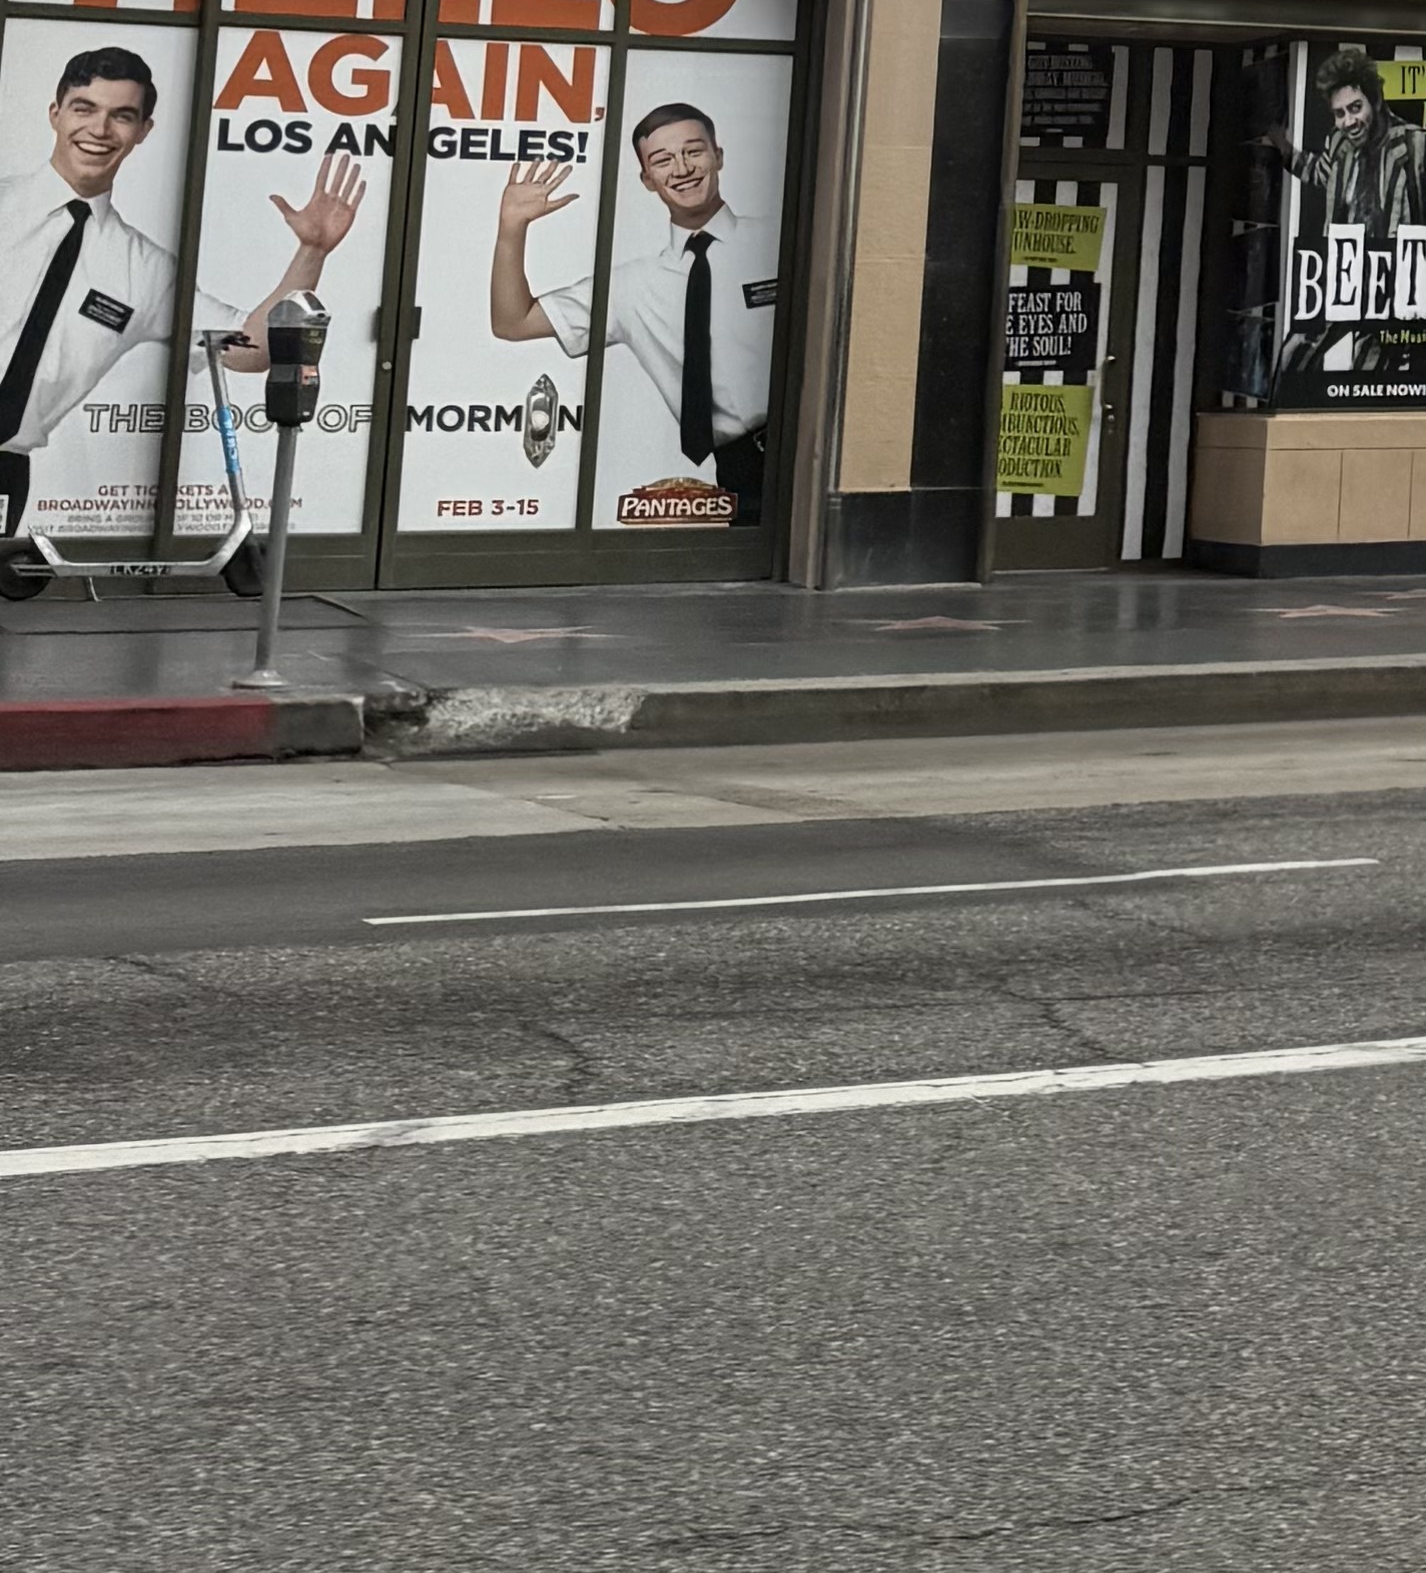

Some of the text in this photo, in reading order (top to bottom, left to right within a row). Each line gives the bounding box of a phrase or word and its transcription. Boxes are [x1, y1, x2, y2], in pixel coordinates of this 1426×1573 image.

[213, 30, 605, 123] AGAIN,
[217, 118, 588, 163] LOS ANGELES!
[1009, 291, 1082, 313] FEAST FOR
[1019, 314, 1053, 335] EYES
[1059, 313, 1087, 333] AND
[1033, 335, 1072, 356] SOUL!
[1327, 384, 1426, 397] ON SALE NOW!
[84, 404, 165, 433] THE
[184, 404, 304, 433] BOO
[317, 404, 373, 433] OF
[98, 485, 129, 496] GET
[437, 499, 539, 516] FEB 3-15
[622, 496, 733, 518] PANTAGES
